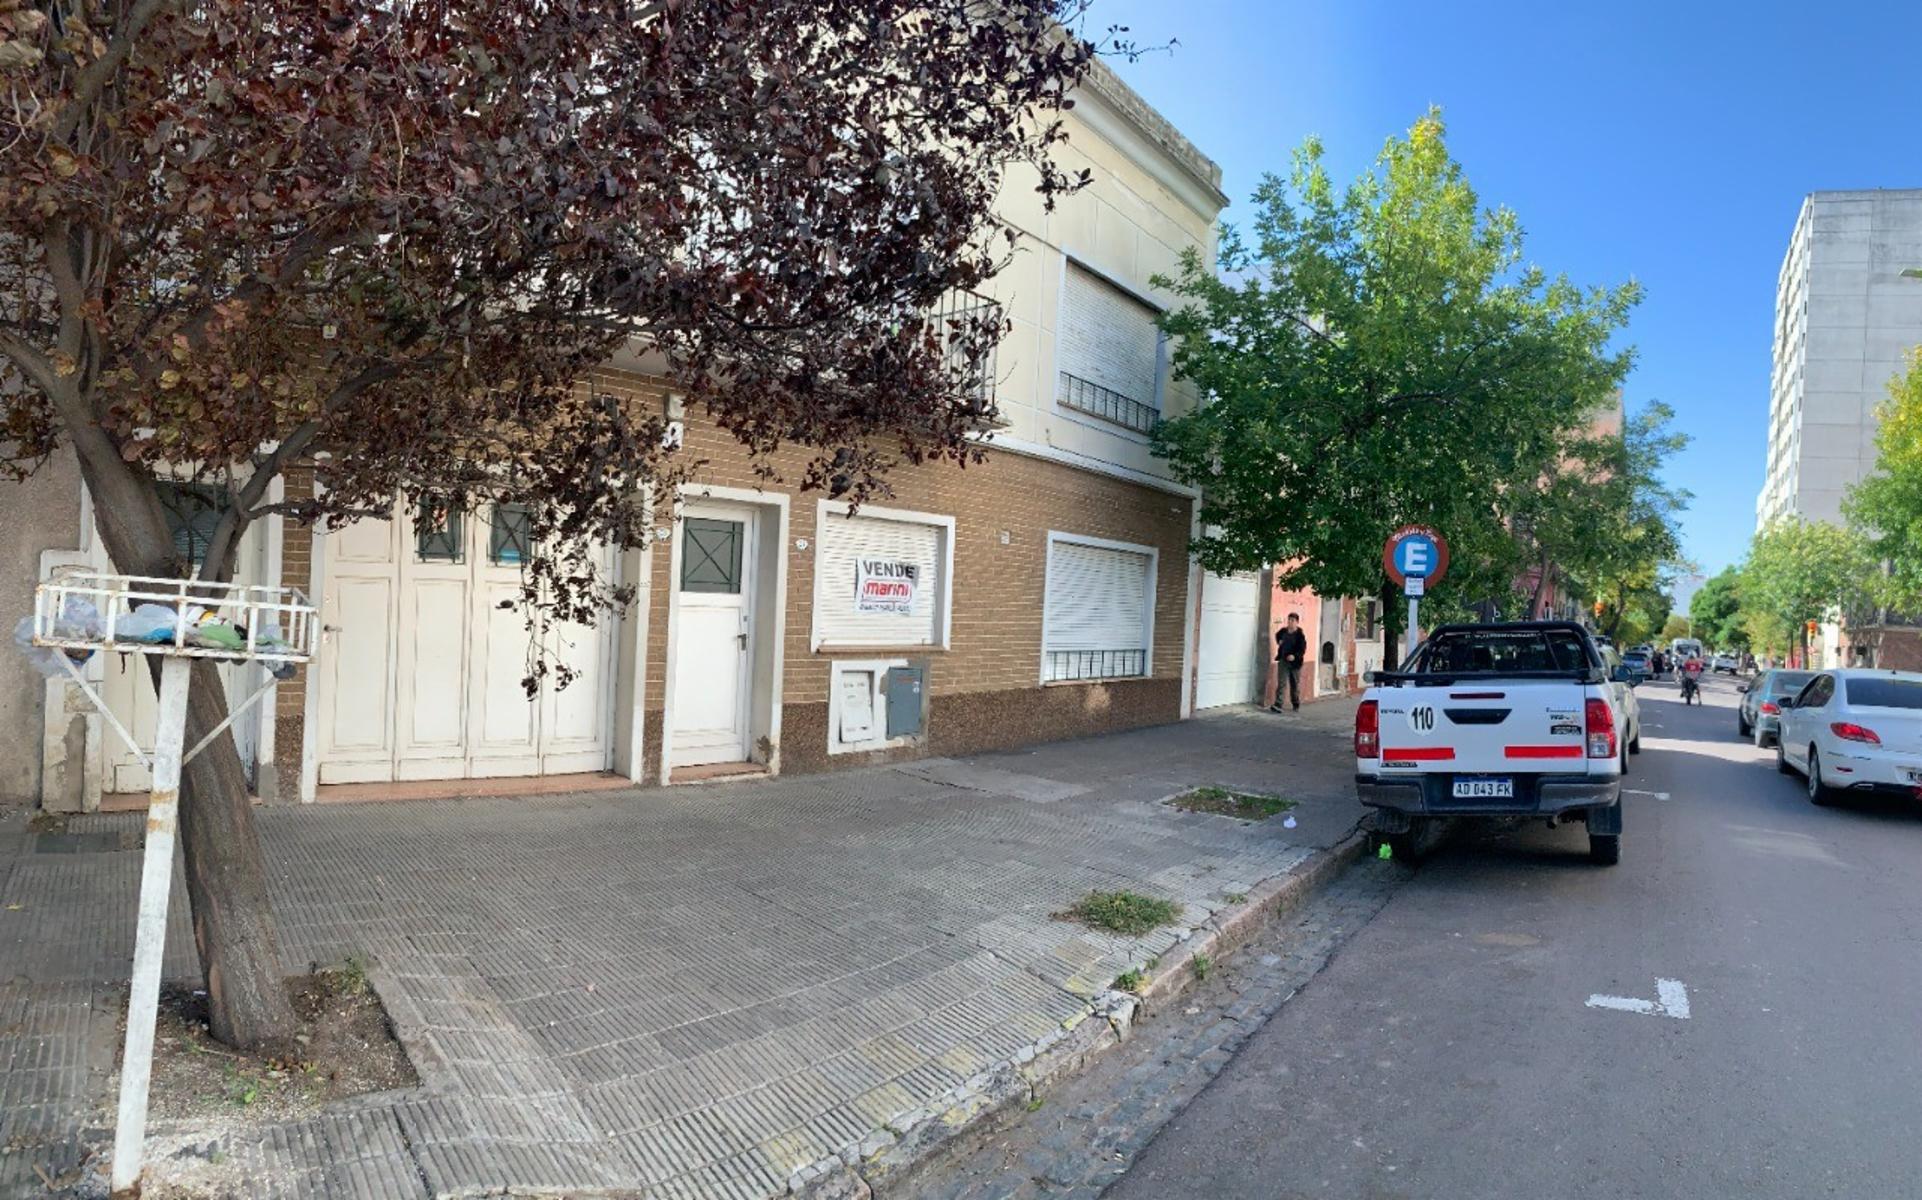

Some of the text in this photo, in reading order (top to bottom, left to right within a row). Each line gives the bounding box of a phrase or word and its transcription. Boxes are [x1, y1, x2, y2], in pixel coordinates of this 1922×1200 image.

[1405, 542, 1427, 571] E
[863, 560, 915, 579] VENDE
[865, 583, 908, 597] marini
[1411, 706, 1434, 731] 110
[1456, 783, 1510, 796] AD 043 FK
